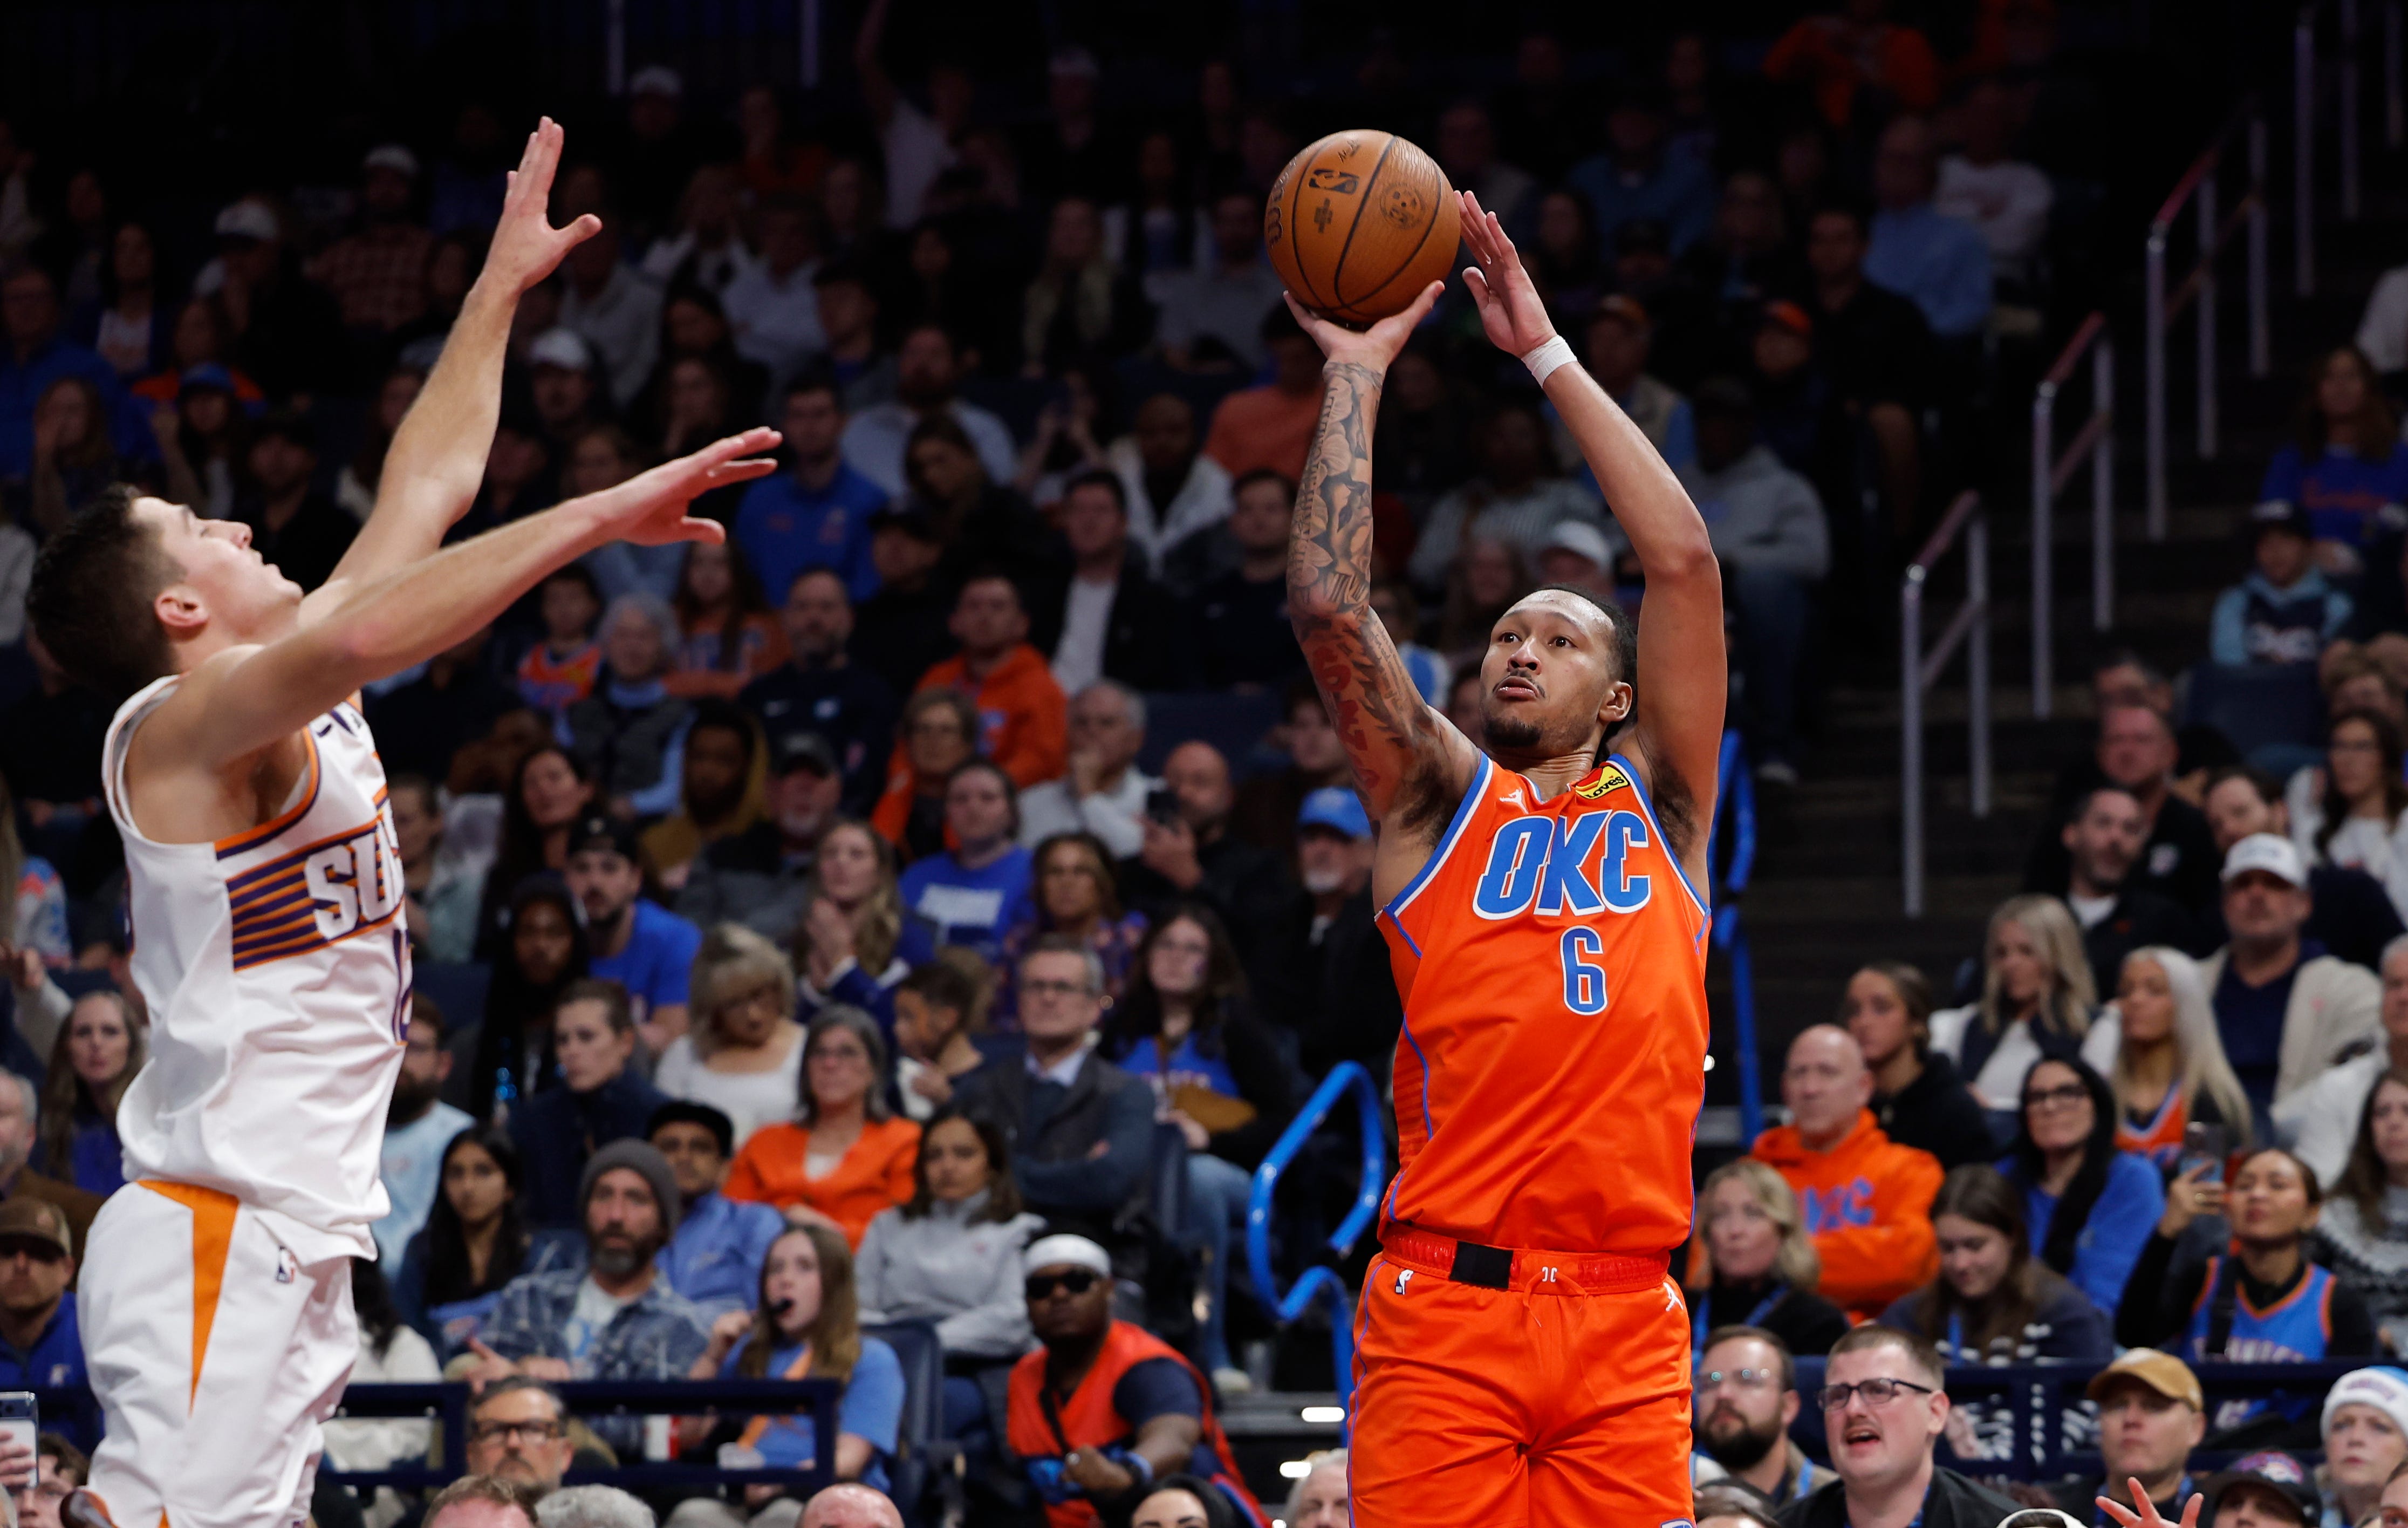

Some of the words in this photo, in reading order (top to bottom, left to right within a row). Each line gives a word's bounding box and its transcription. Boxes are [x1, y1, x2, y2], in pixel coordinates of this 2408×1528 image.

[1472, 809, 1652, 920] OKC
[1559, 925, 1607, 1016] 6
[1803, 1175, 1876, 1236] KC
